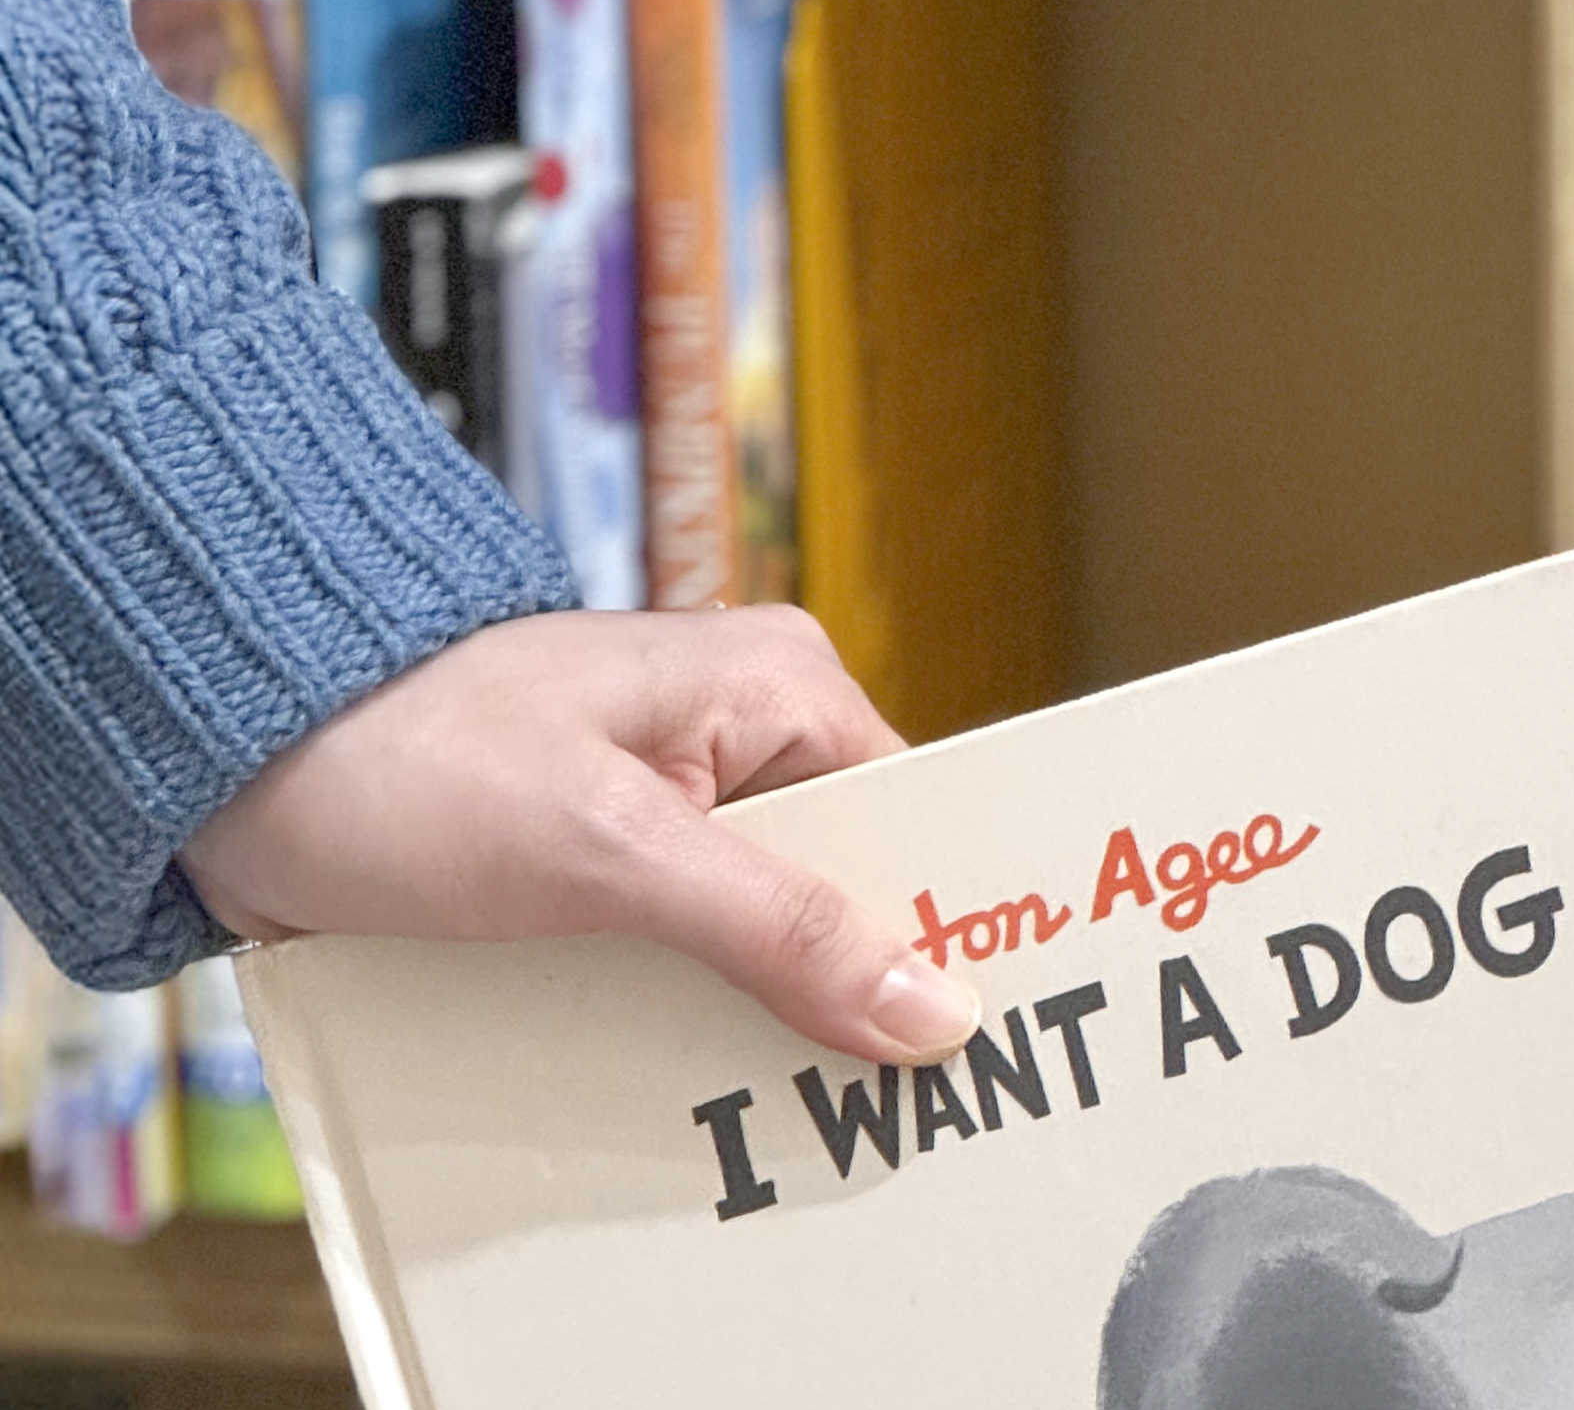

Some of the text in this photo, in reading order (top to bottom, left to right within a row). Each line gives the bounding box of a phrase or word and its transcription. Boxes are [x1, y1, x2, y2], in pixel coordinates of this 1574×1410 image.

[1090, 815, 1320, 932] Agee
[692, 845, 1565, 1222] I WANT A DOG
